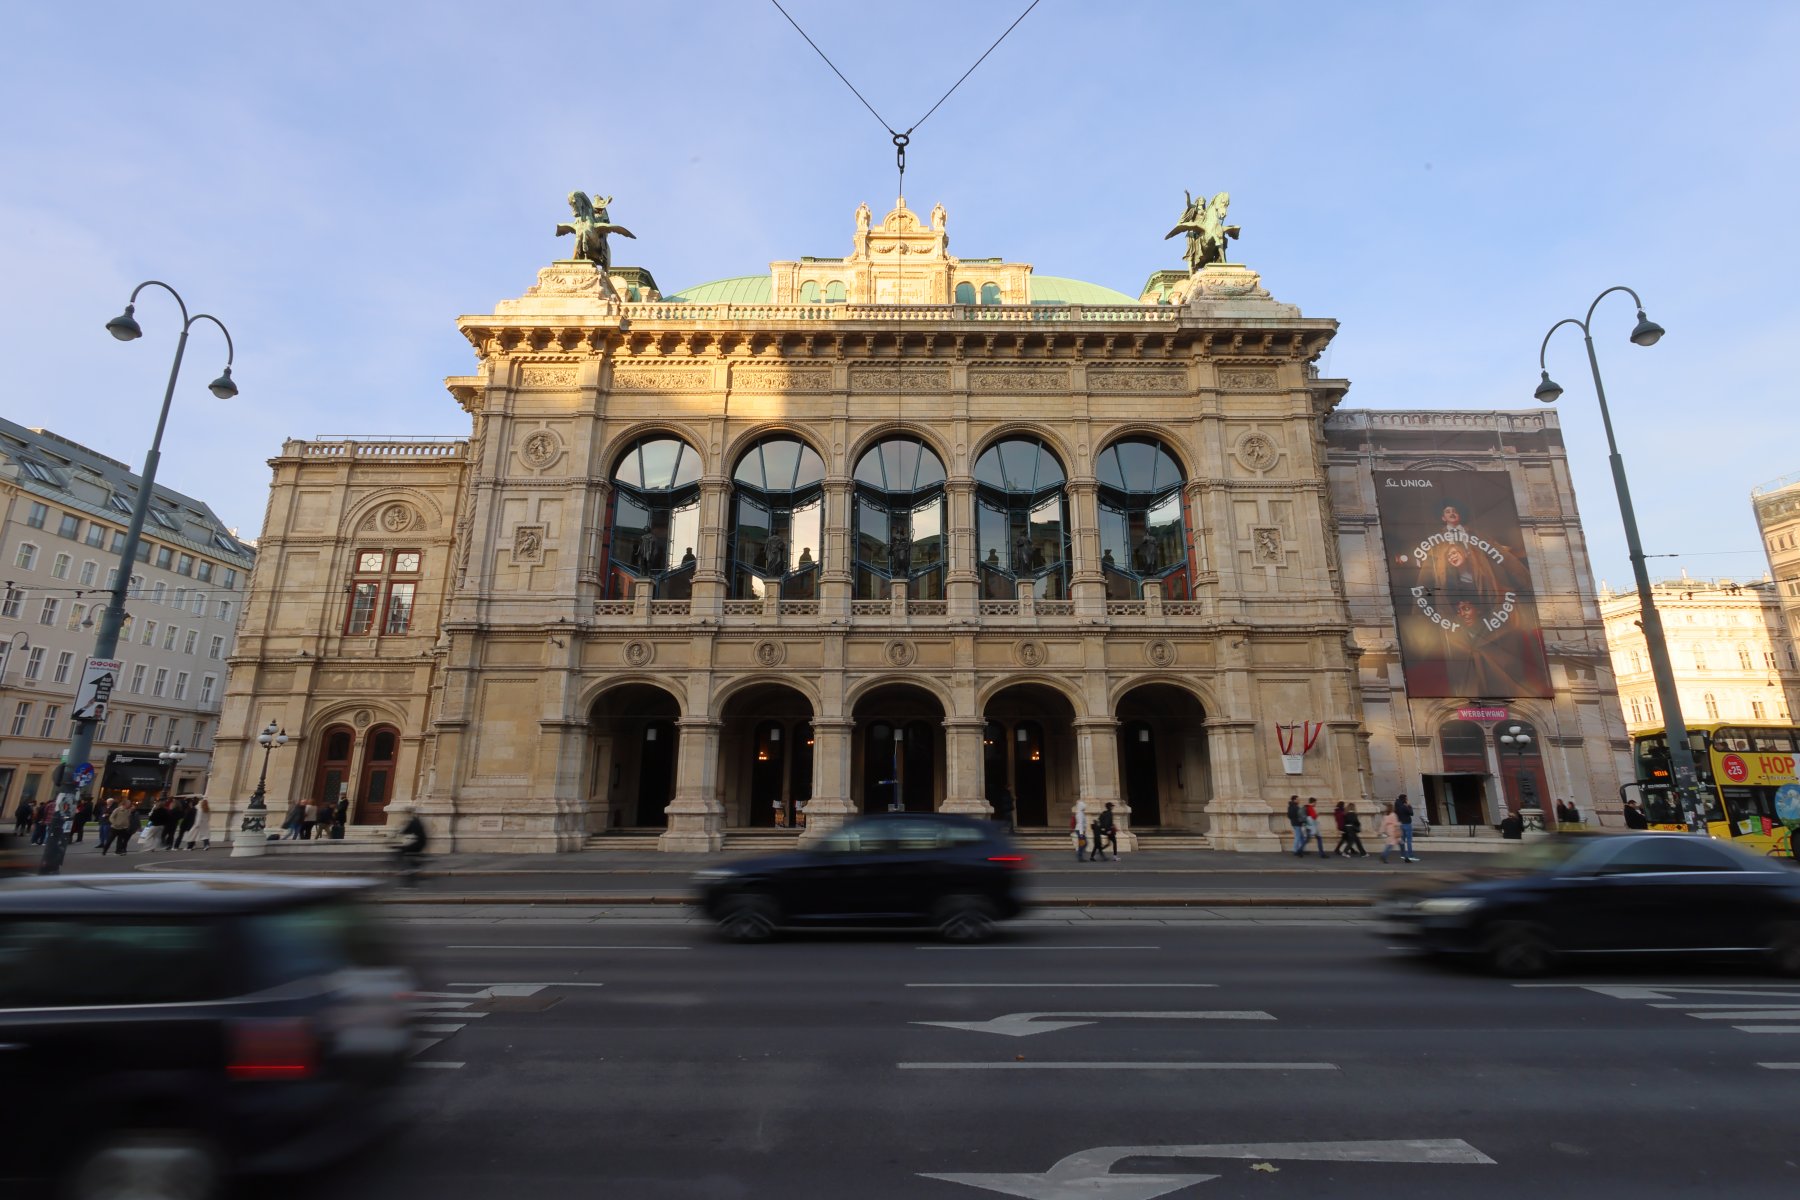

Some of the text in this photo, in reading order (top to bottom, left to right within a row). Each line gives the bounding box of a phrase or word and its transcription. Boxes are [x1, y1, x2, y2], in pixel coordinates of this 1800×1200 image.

[1400, 479, 1433, 488] UNIQA
[1413, 528, 1505, 565] gemeinsam
[1410, 585, 1460, 632] besser
[1483, 591, 1516, 632] leben
[1460, 710, 1505, 718] WERBEWAND
[1758, 756, 1796, 774] HOP
